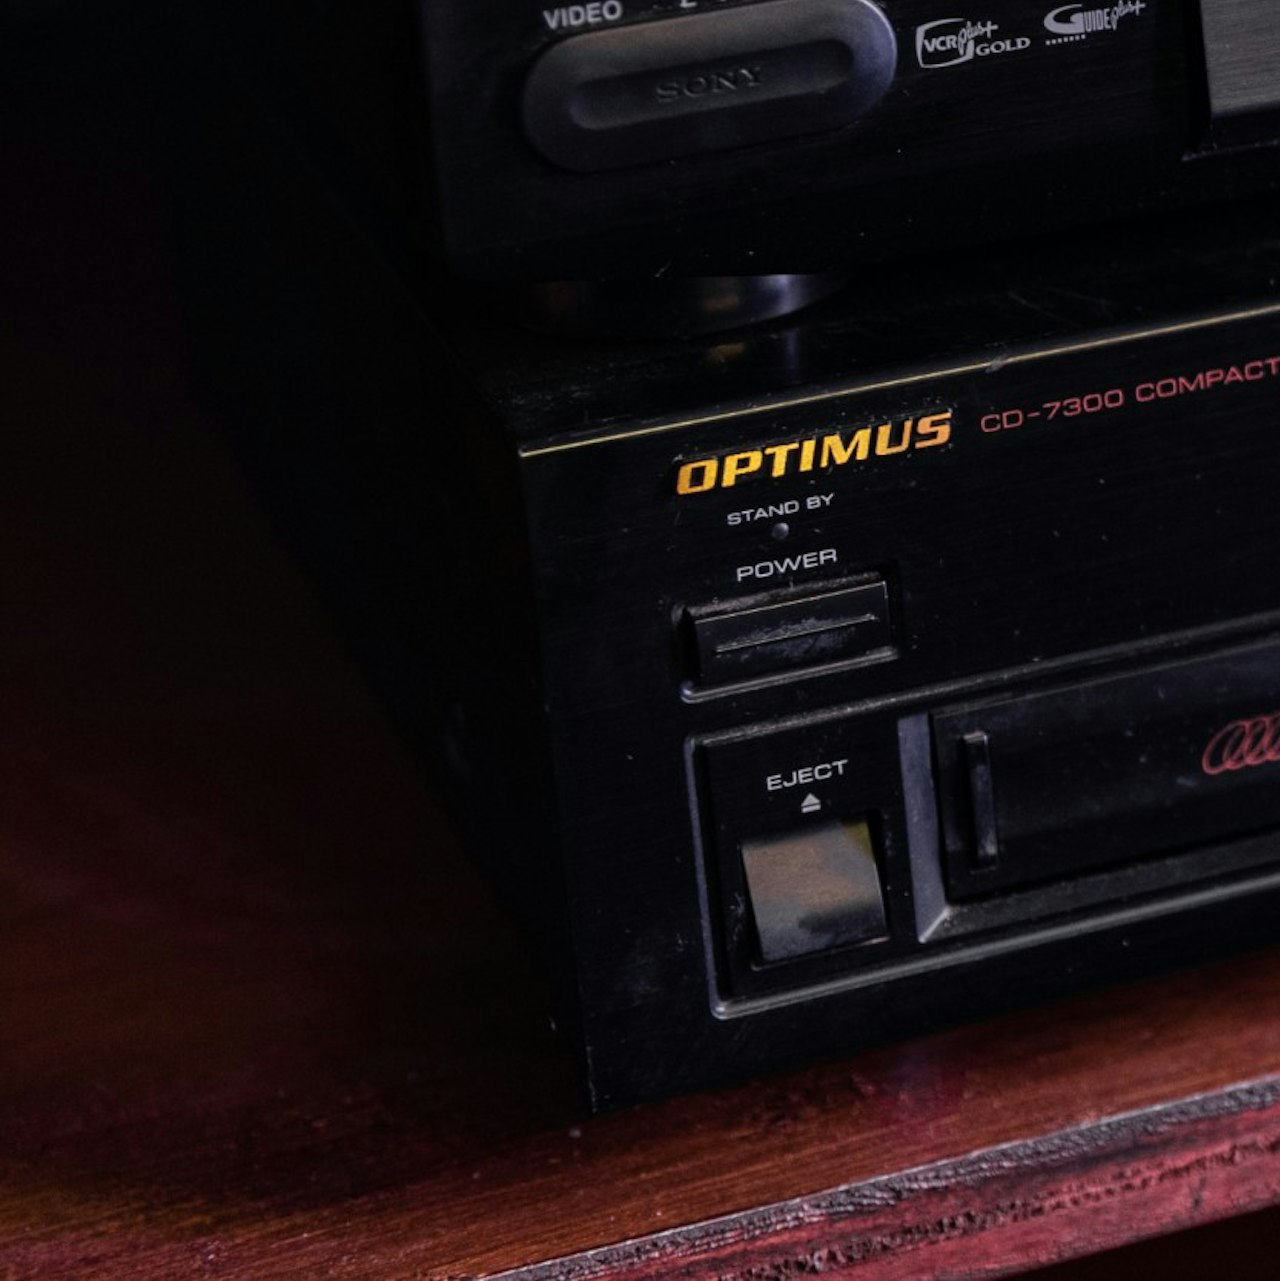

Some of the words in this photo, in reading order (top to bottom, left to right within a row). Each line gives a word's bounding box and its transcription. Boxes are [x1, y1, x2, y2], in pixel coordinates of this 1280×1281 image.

[543, 0, 623, 30] VIDEO
[975, 37, 1032, 57] GOLD
[655, 64, 764, 104] SONY
[980, 388, 1126, 434] CD-7300
[1134, 357, 1280, 404] COMPACT
[673, 408, 955, 497] OPTIMUS
[726, 500, 799, 527] STAND
[806, 492, 836, 510] BY
[736, 548, 839, 583] POWER
[765, 759, 849, 792] EJECT
